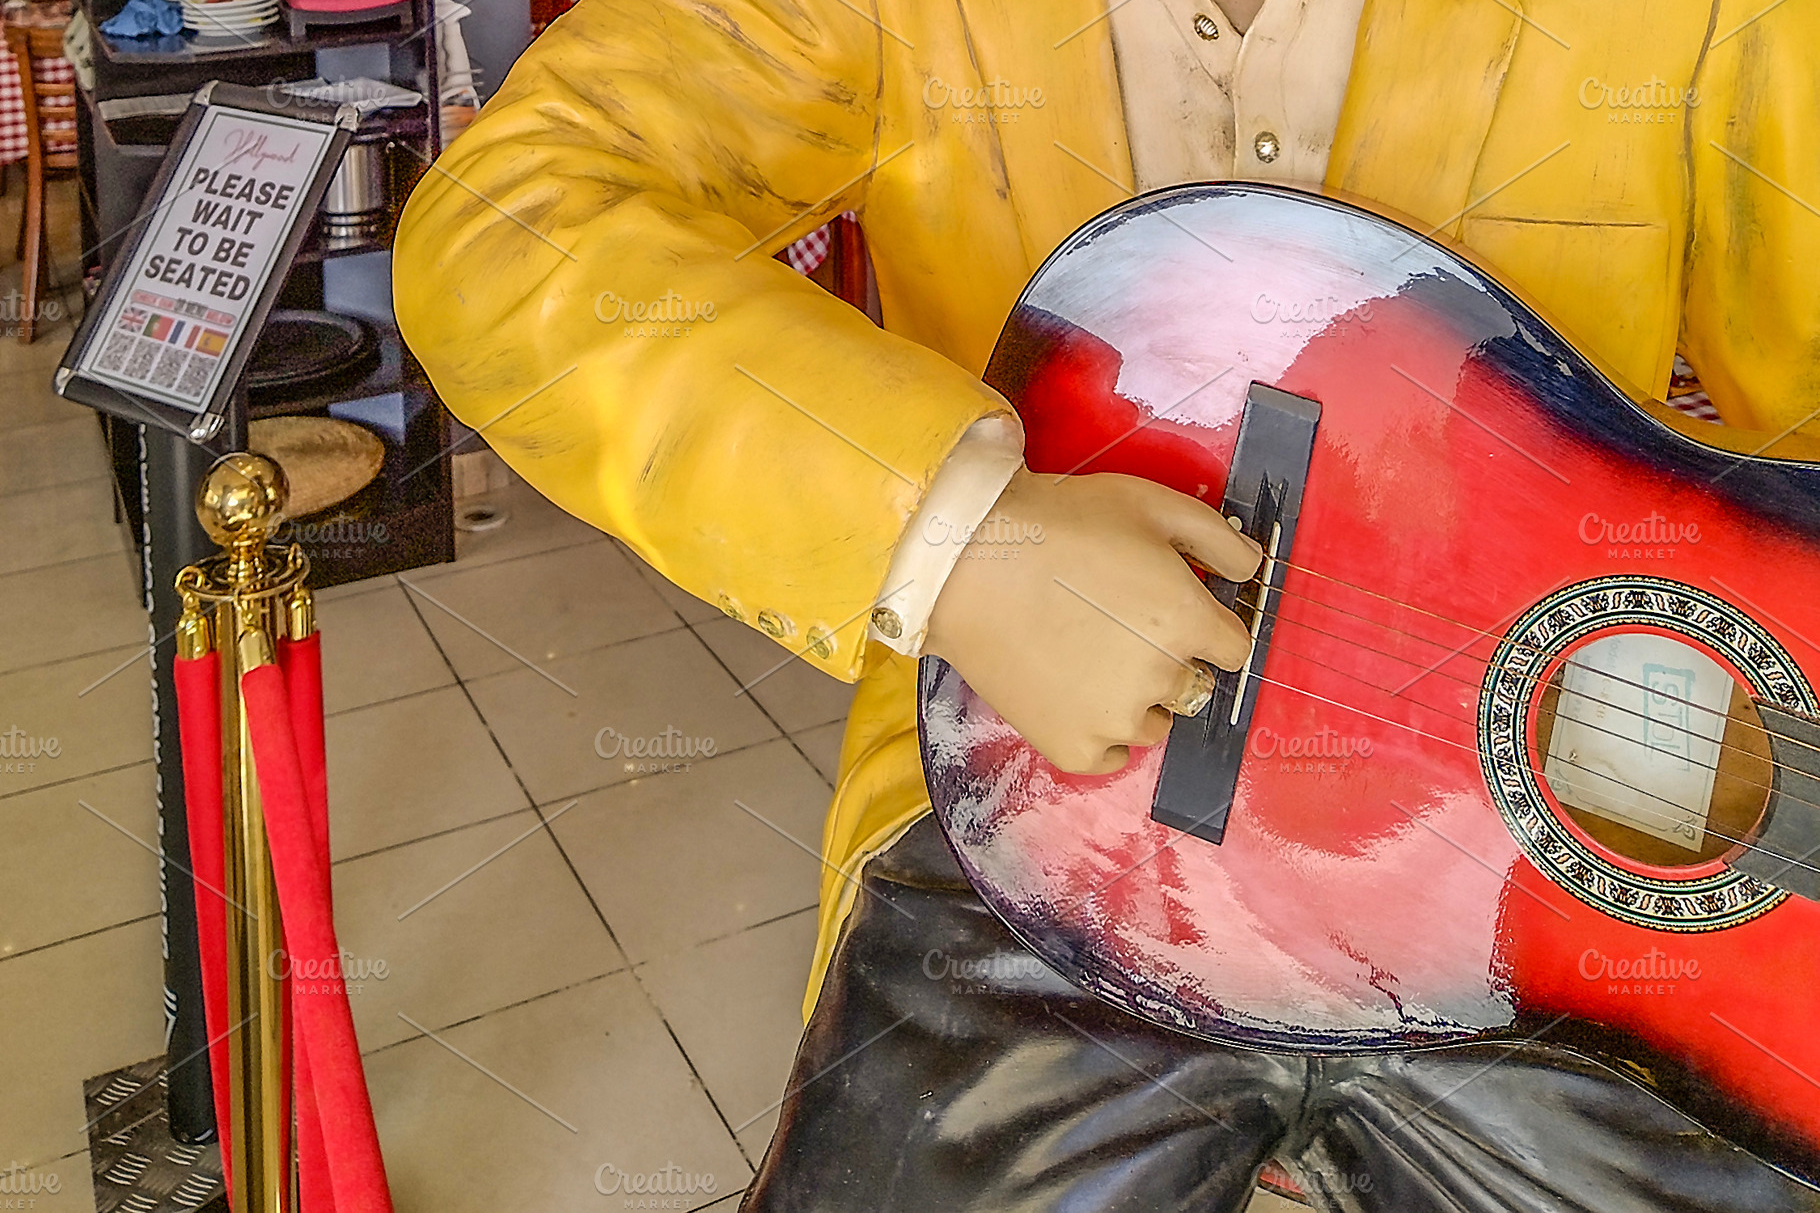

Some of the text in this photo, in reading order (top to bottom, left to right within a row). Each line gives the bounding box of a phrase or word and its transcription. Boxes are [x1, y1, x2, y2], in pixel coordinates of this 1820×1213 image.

[189, 166, 296, 211] PLEASE
[191, 198, 265, 236] WAIT
[173, 226, 255, 268] TO BE
[144, 253, 251, 301] SEATED
